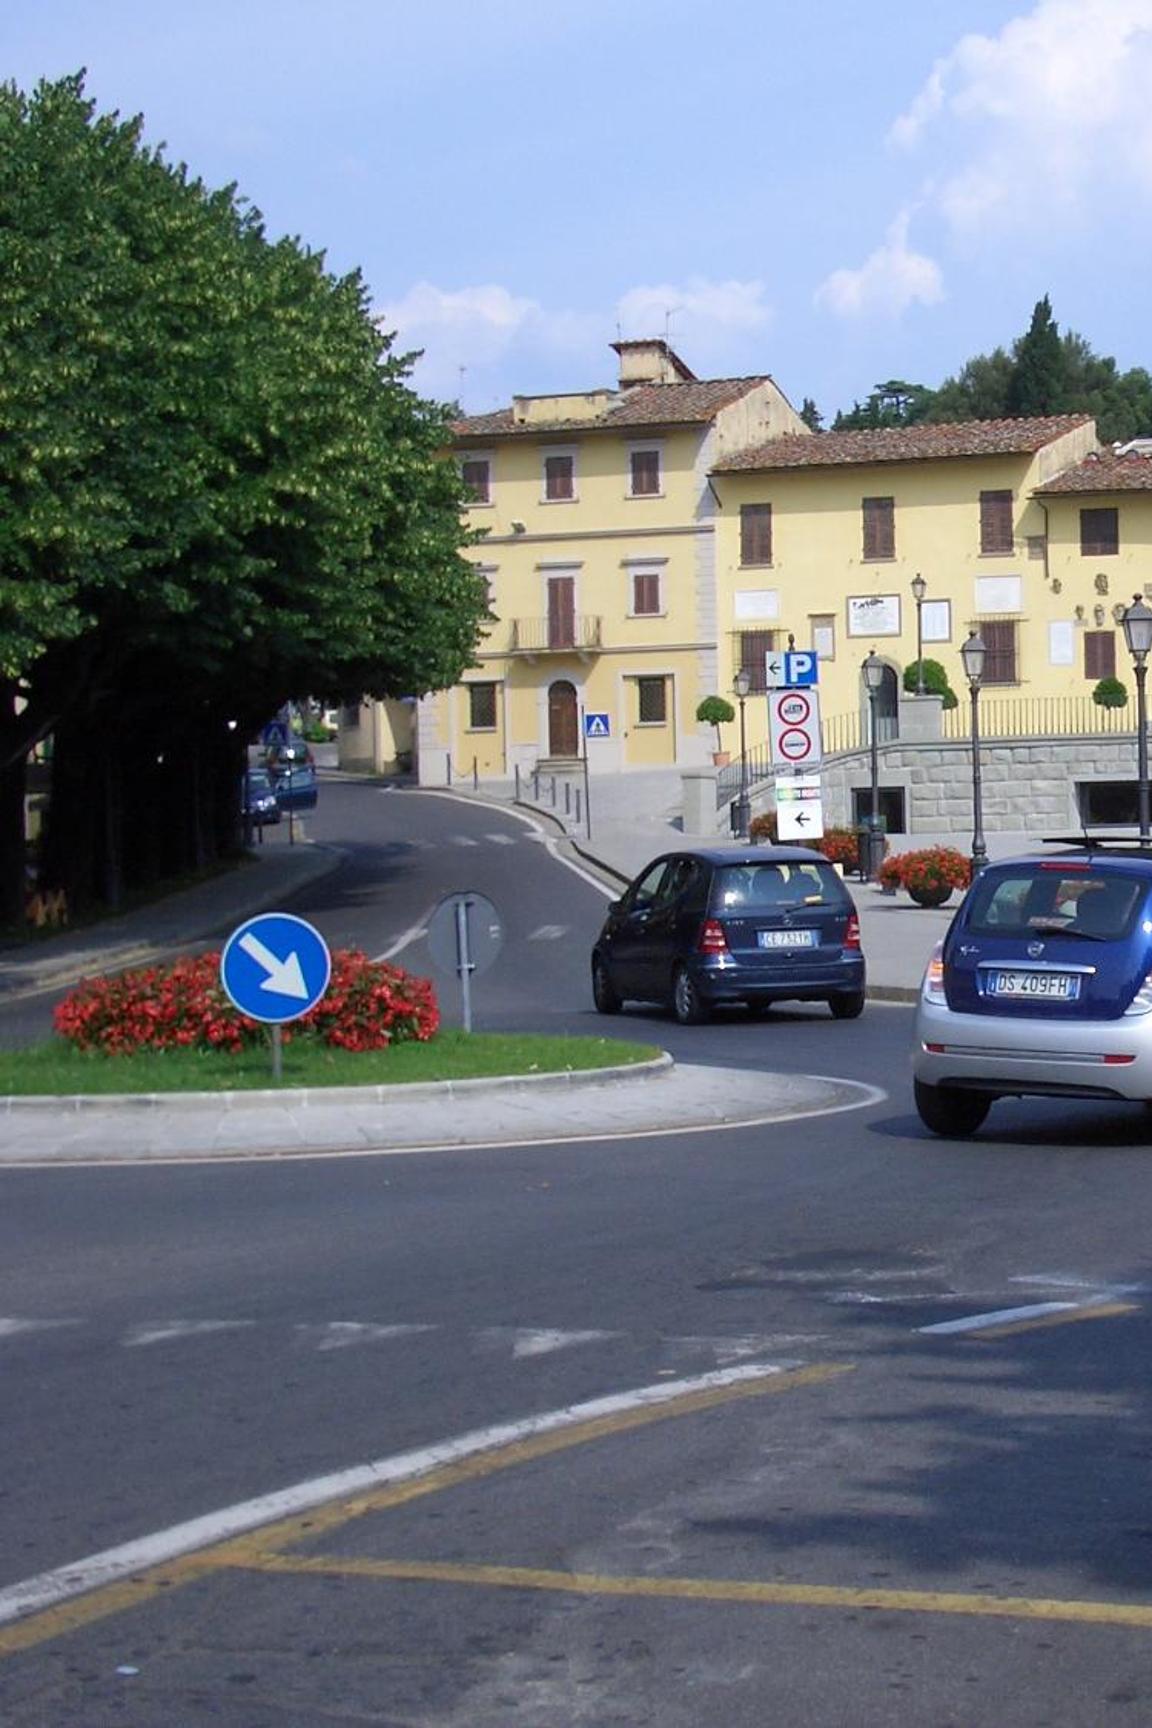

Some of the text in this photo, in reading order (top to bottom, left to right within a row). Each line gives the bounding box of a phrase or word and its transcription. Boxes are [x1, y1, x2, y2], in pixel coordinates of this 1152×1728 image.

[790, 654, 812, 682] P
[997, 974, 1068, 994] DS 409FH
